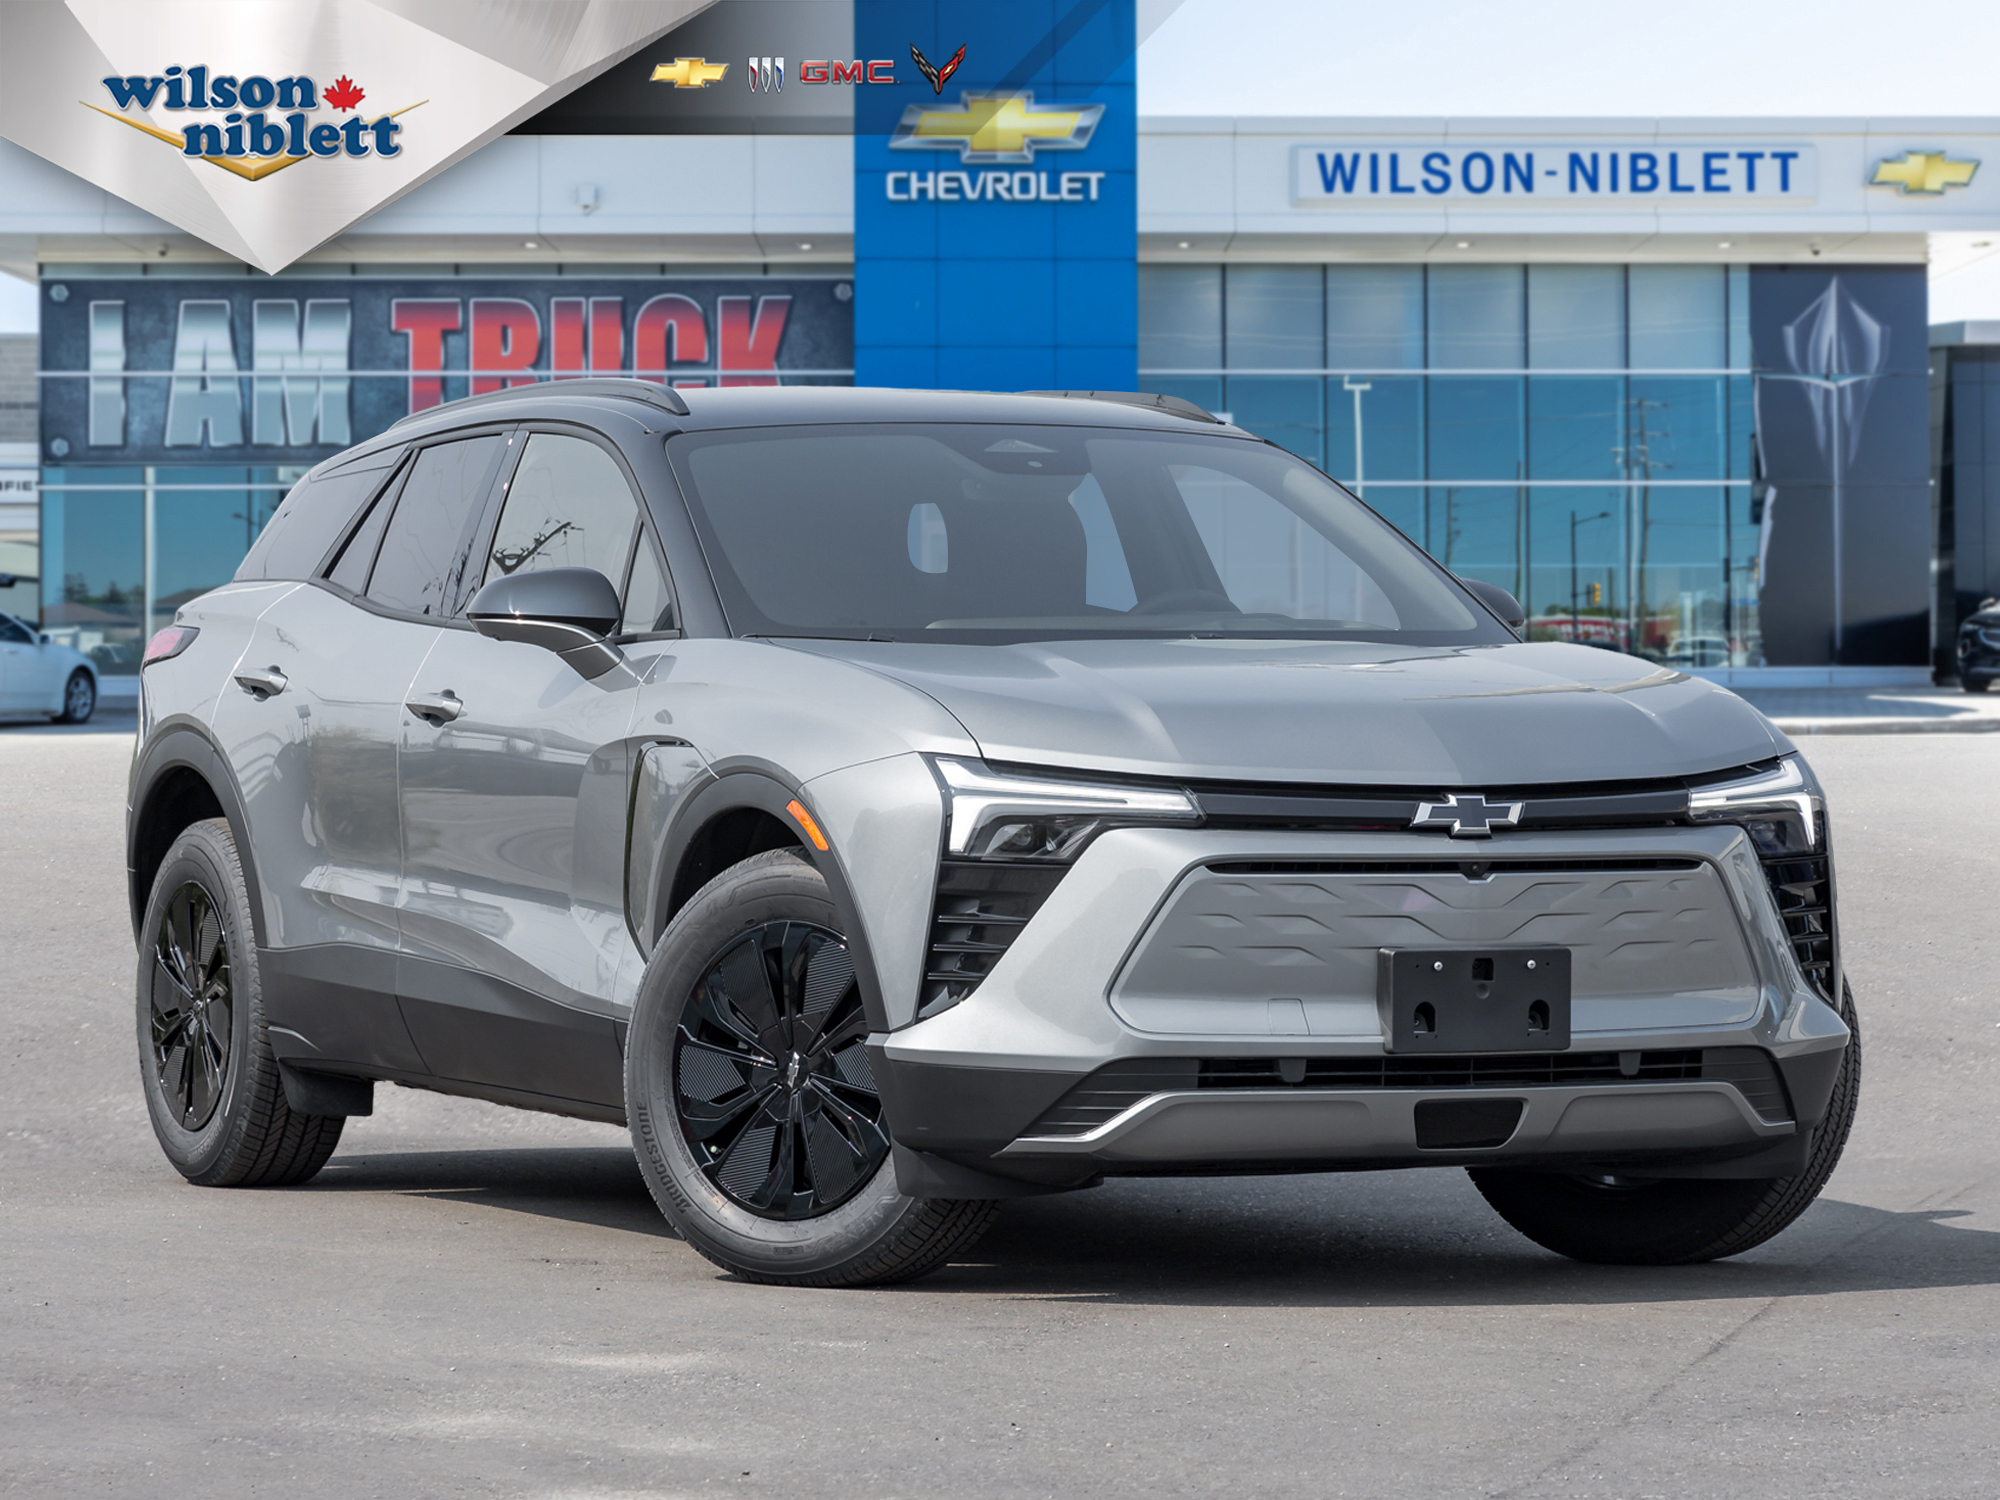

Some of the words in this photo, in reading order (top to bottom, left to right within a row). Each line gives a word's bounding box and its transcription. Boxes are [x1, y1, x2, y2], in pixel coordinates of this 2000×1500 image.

[886, 171, 1105, 201] CHEVROLET
[1316, 151, 1800, 194] WILSON-NIBLETT
[89, 300, 126, 447] I
[164, 299, 351, 447] AM
[392, 293, 793, 417] TRUCK
[636, 1101, 692, 1214] BRIDGESTONE
